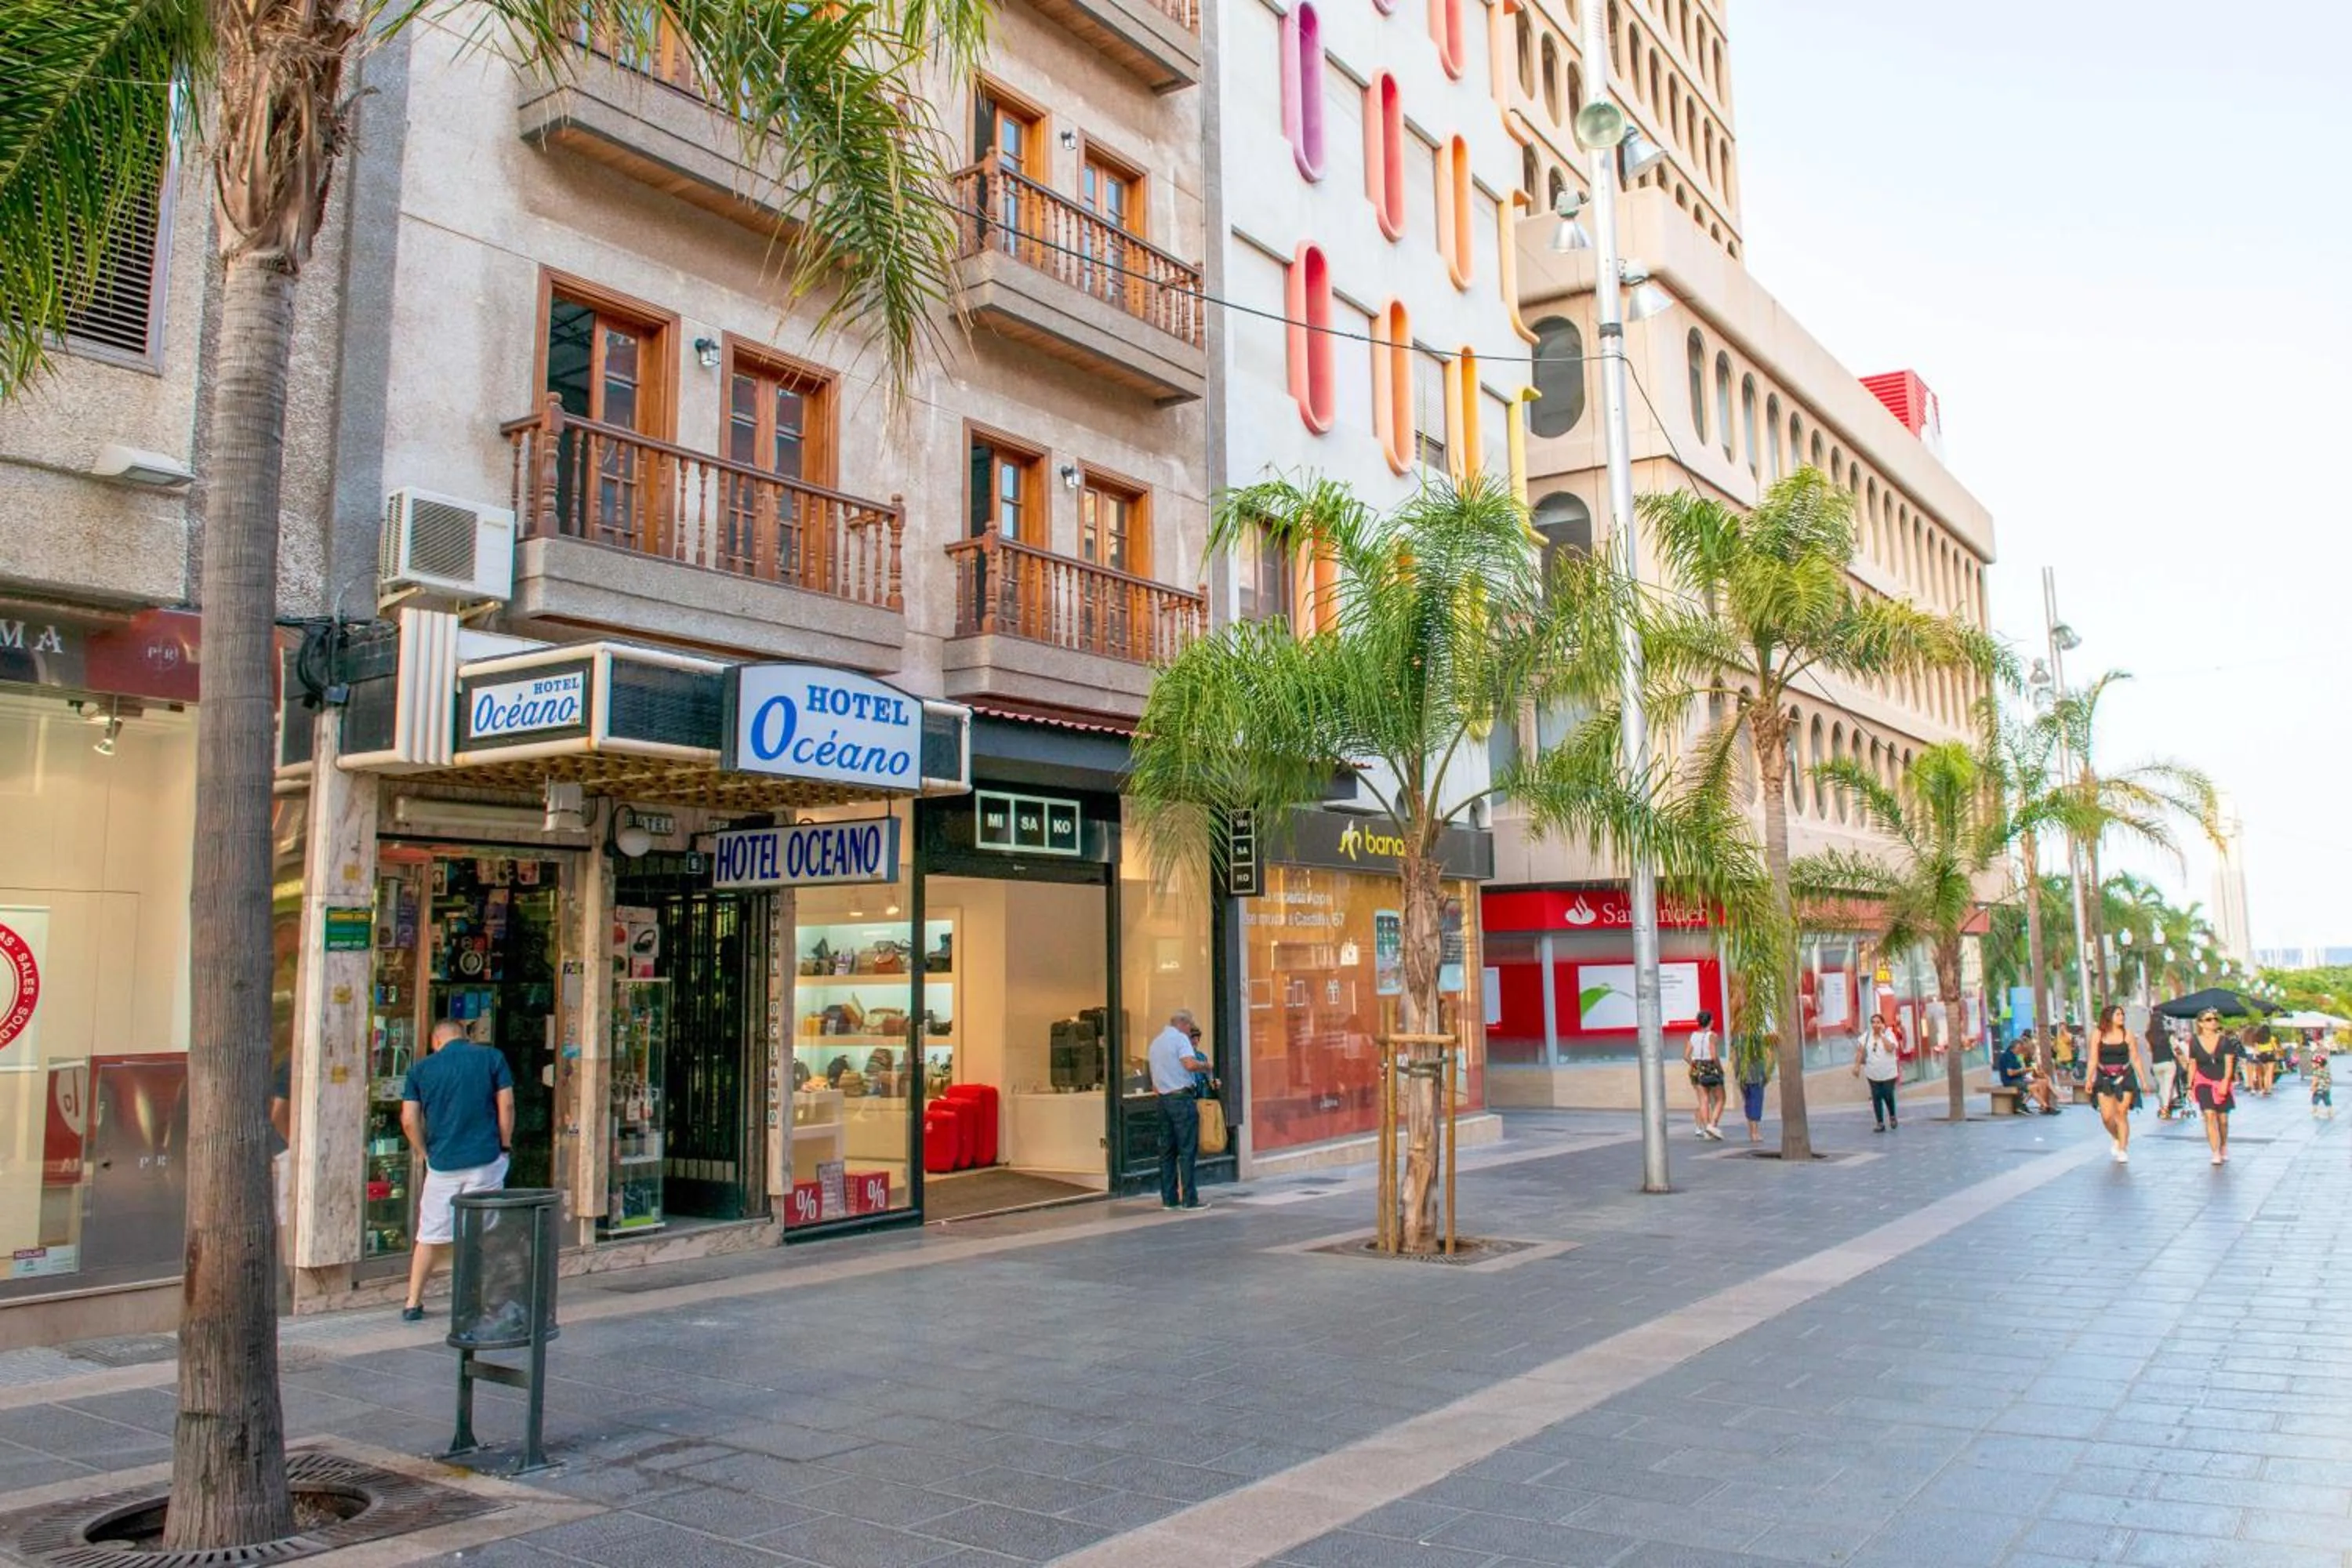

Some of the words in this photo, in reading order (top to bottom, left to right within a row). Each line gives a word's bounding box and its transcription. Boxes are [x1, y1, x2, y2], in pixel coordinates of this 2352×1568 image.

[534, 677, 579, 695] HOTEL
[474, 693, 579, 732] Océano
[806, 684, 909, 726] HOTEL
[750, 695, 909, 775] Océano
[988, 813, 1003, 829] MI
[1021, 816, 1038, 831] SA
[1053, 819, 1072, 835] KO
[1366, 825, 1406, 857] bana
[717, 834, 781, 882] HOTEL
[787, 826, 880, 878] OCEANO
[1602, 902, 1708, 924] Sander
[17, 953, 34, 995] SALES
[0, 1007, 29, 1041] SOLD
